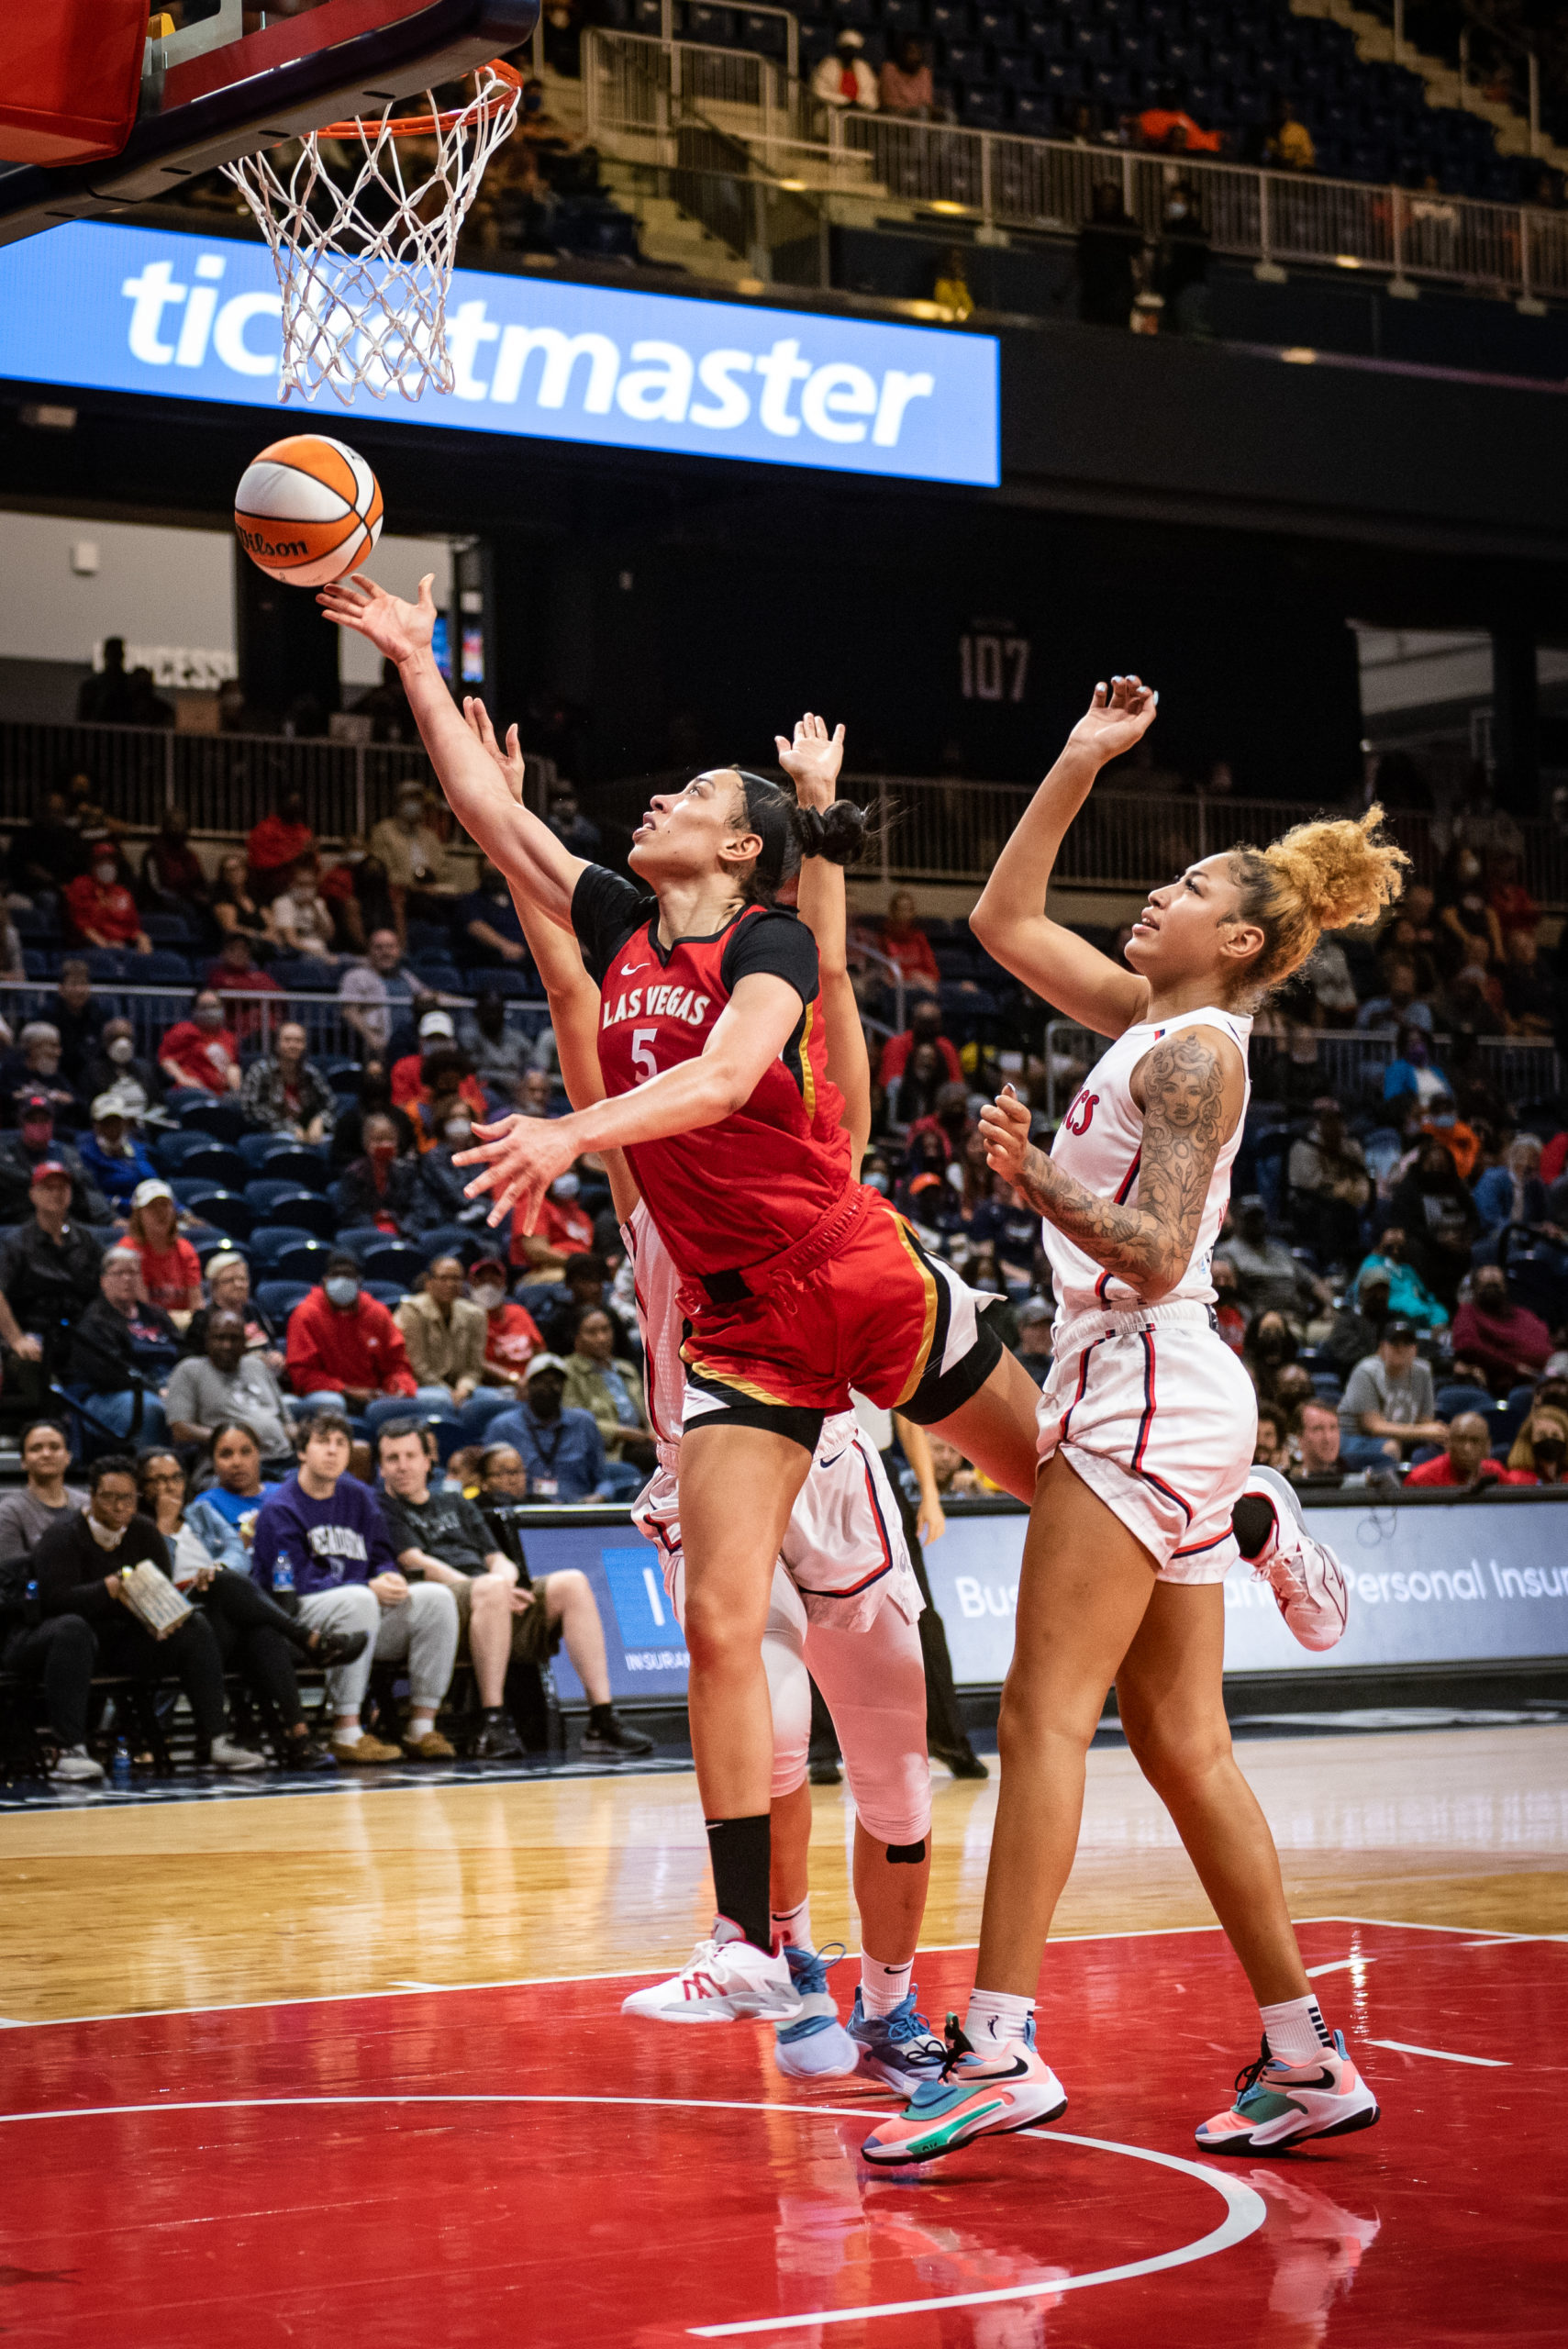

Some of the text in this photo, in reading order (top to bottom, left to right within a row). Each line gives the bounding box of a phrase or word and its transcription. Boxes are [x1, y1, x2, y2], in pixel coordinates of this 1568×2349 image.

[121, 253, 935, 448] ticketmaster
[959, 633, 1031, 703] 107
[602, 985, 711, 1030] LAS VEGAS
[630, 1028, 658, 1084] 5
